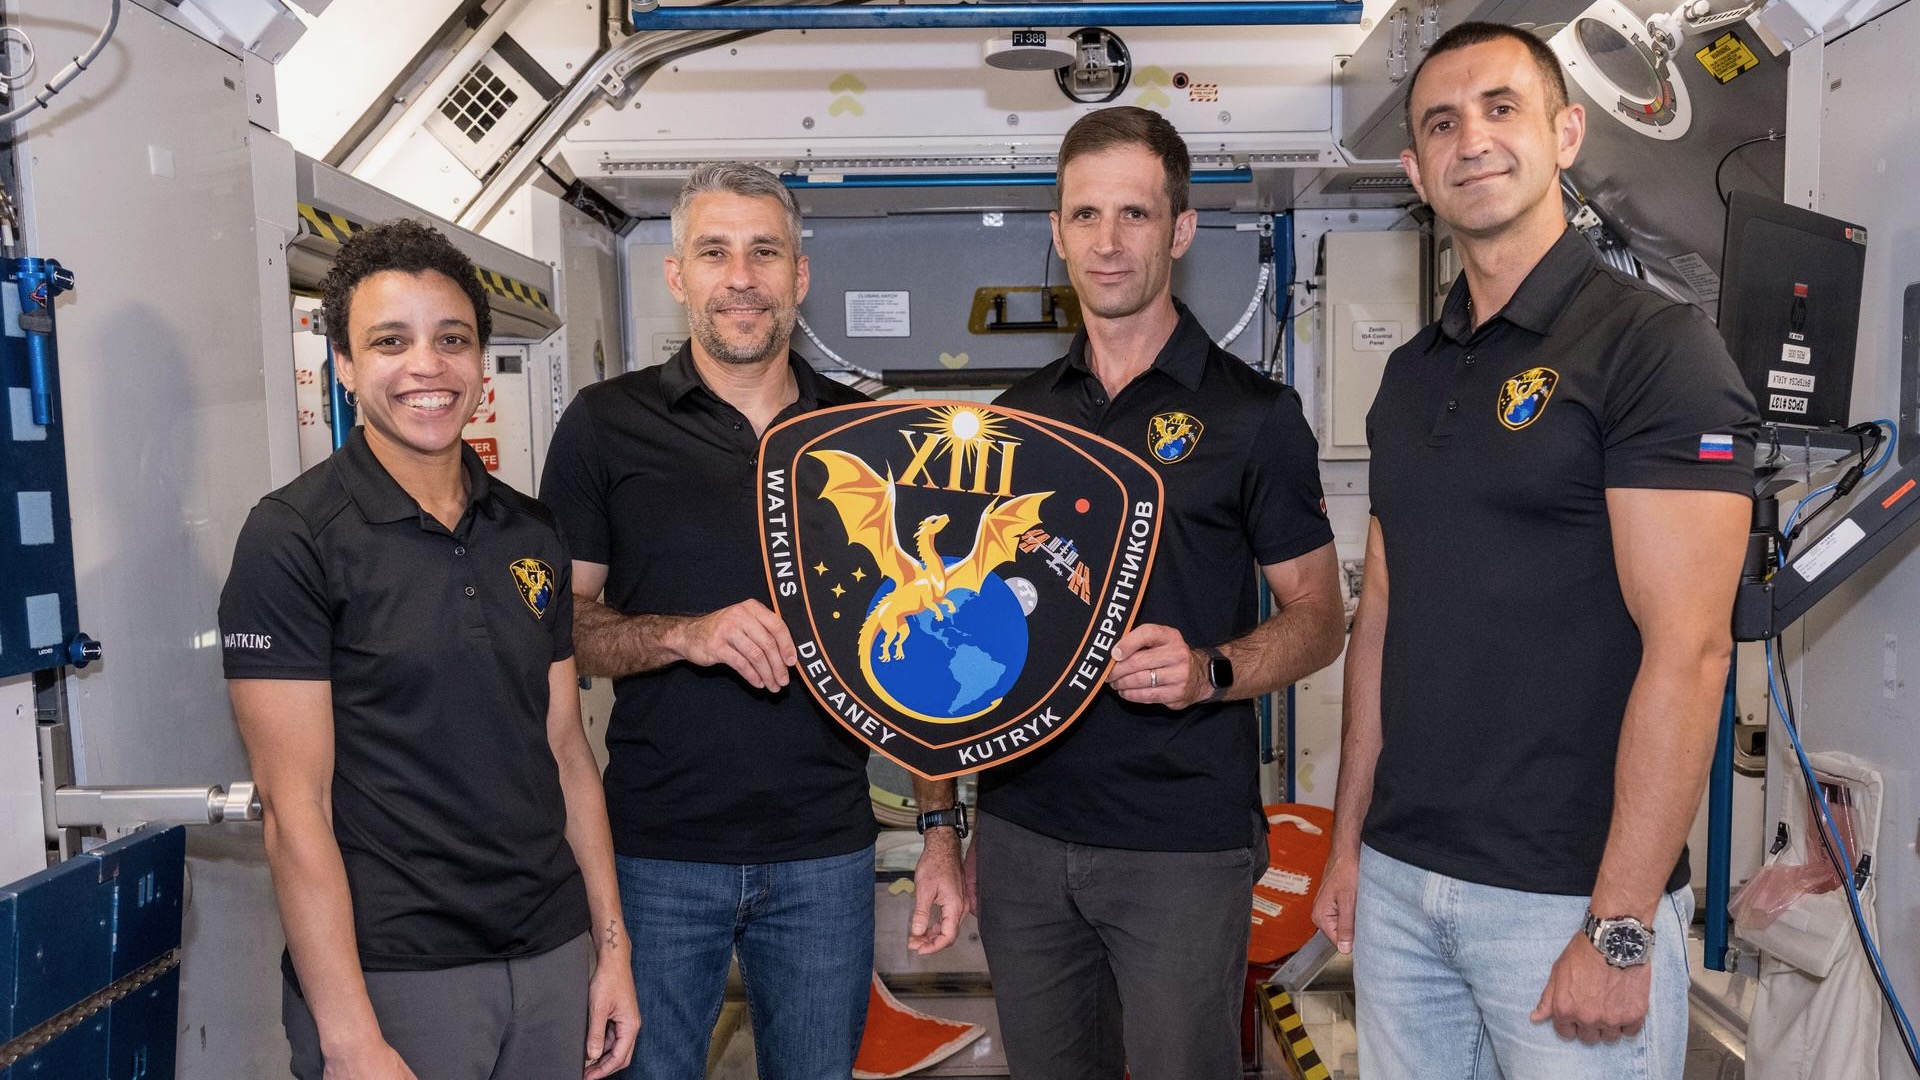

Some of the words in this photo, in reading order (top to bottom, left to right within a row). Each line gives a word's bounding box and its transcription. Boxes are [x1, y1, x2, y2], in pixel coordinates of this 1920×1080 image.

[1026, 33, 1045, 44] 388
[479, 455, 497, 465] FE
[895, 429, 1022, 498] XIII
[767, 469, 797, 597] WATKINS
[1068, 501, 1153, 691] ТЕТЕРЯТНИКОВ
[224, 633, 272, 649] WATKINS
[798, 640, 897, 745] DELANEY
[958, 706, 1062, 766] KUTRYK
